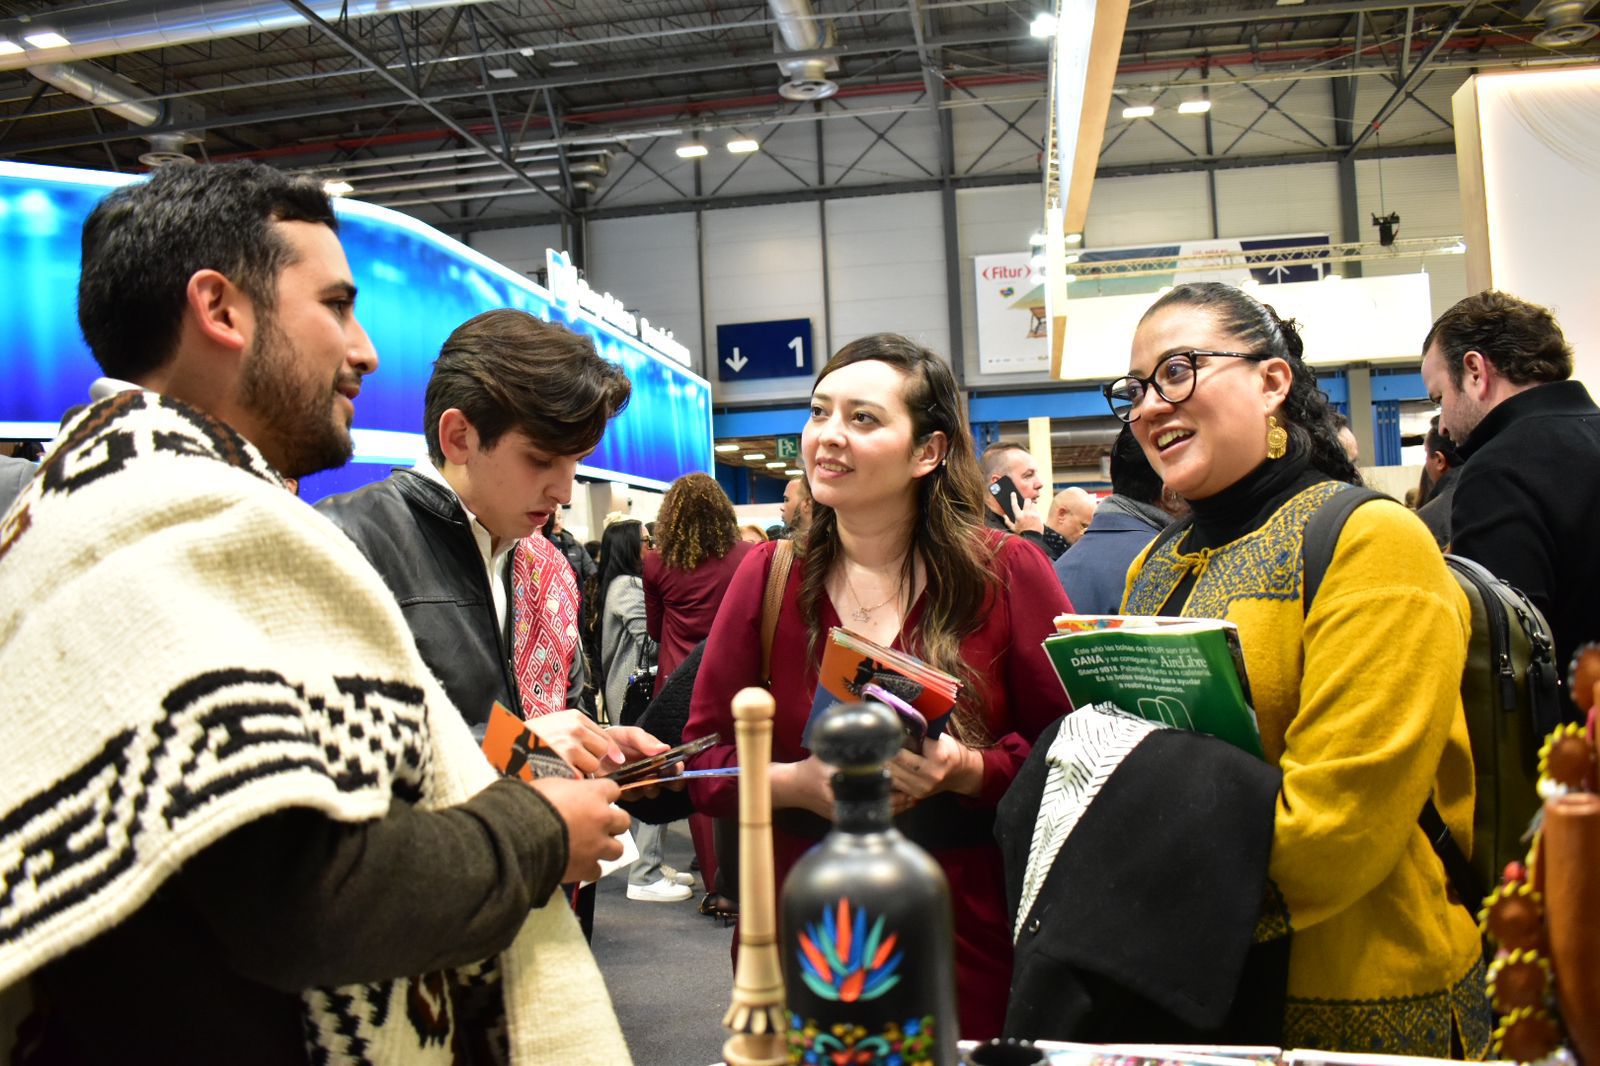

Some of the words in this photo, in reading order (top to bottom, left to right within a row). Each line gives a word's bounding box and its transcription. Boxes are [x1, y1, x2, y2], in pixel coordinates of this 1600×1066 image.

[787, 336, 804, 368] 1
[1115, 644, 1135, 652] bolsas
[1071, 654, 1105, 667] DANA
[1160, 655, 1208, 668] AireLibre
[1078, 667, 1099, 676] Stand
[1114, 673, 1133, 681] bolsa
[1134, 674, 1160, 683] solidaria
[1160, 677, 1176, 685] para
[1177, 677, 1201, 687] ayudar
